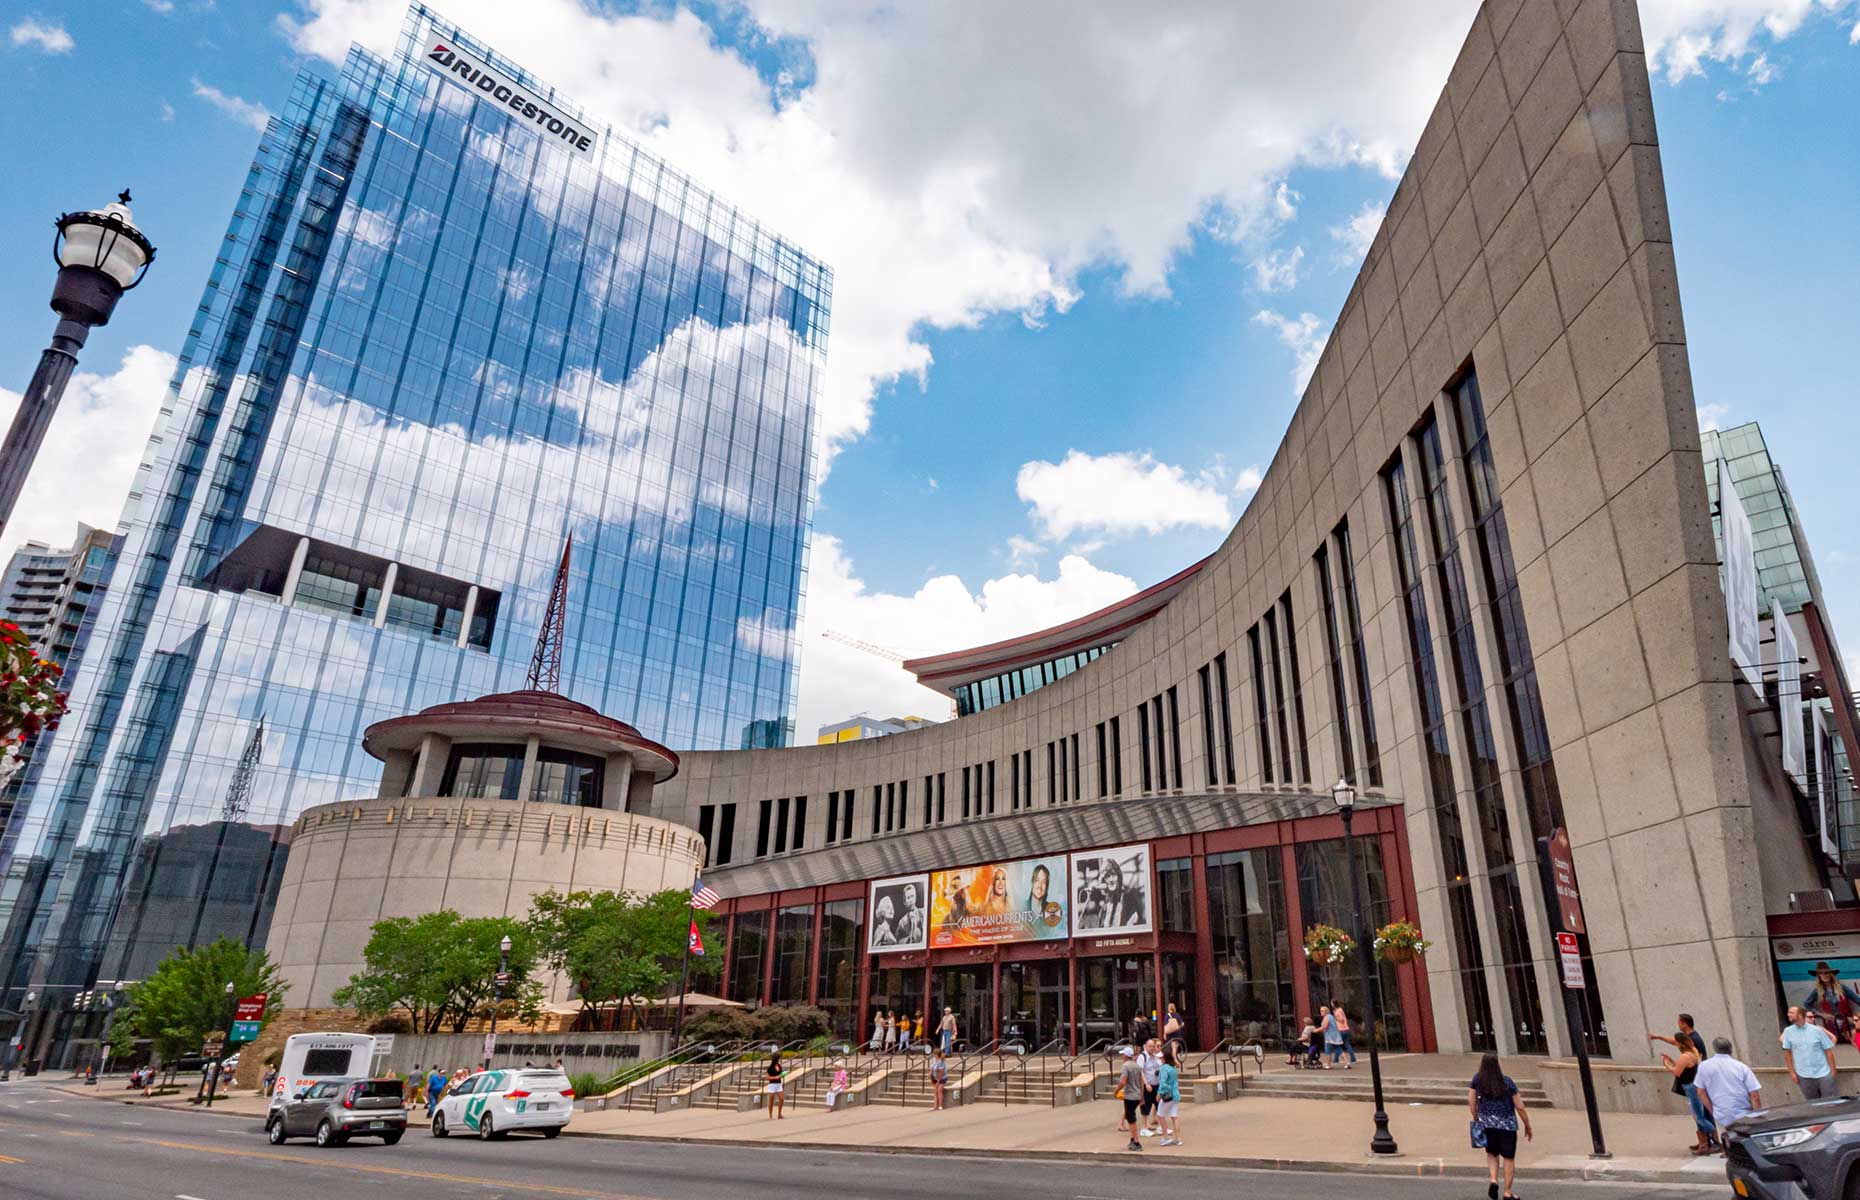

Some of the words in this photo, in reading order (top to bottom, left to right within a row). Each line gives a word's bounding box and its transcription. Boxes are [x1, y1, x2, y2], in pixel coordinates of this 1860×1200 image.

[428, 44, 592, 152] BRIDGESTONE
[961, 913, 996, 928] AMERICAN
[996, 910, 1033, 926] CURRENTS
[1802, 940, 1835, 948] circa
[553, 1044, 564, 1056] OF
[603, 1044, 640, 1058] MUSEUM
